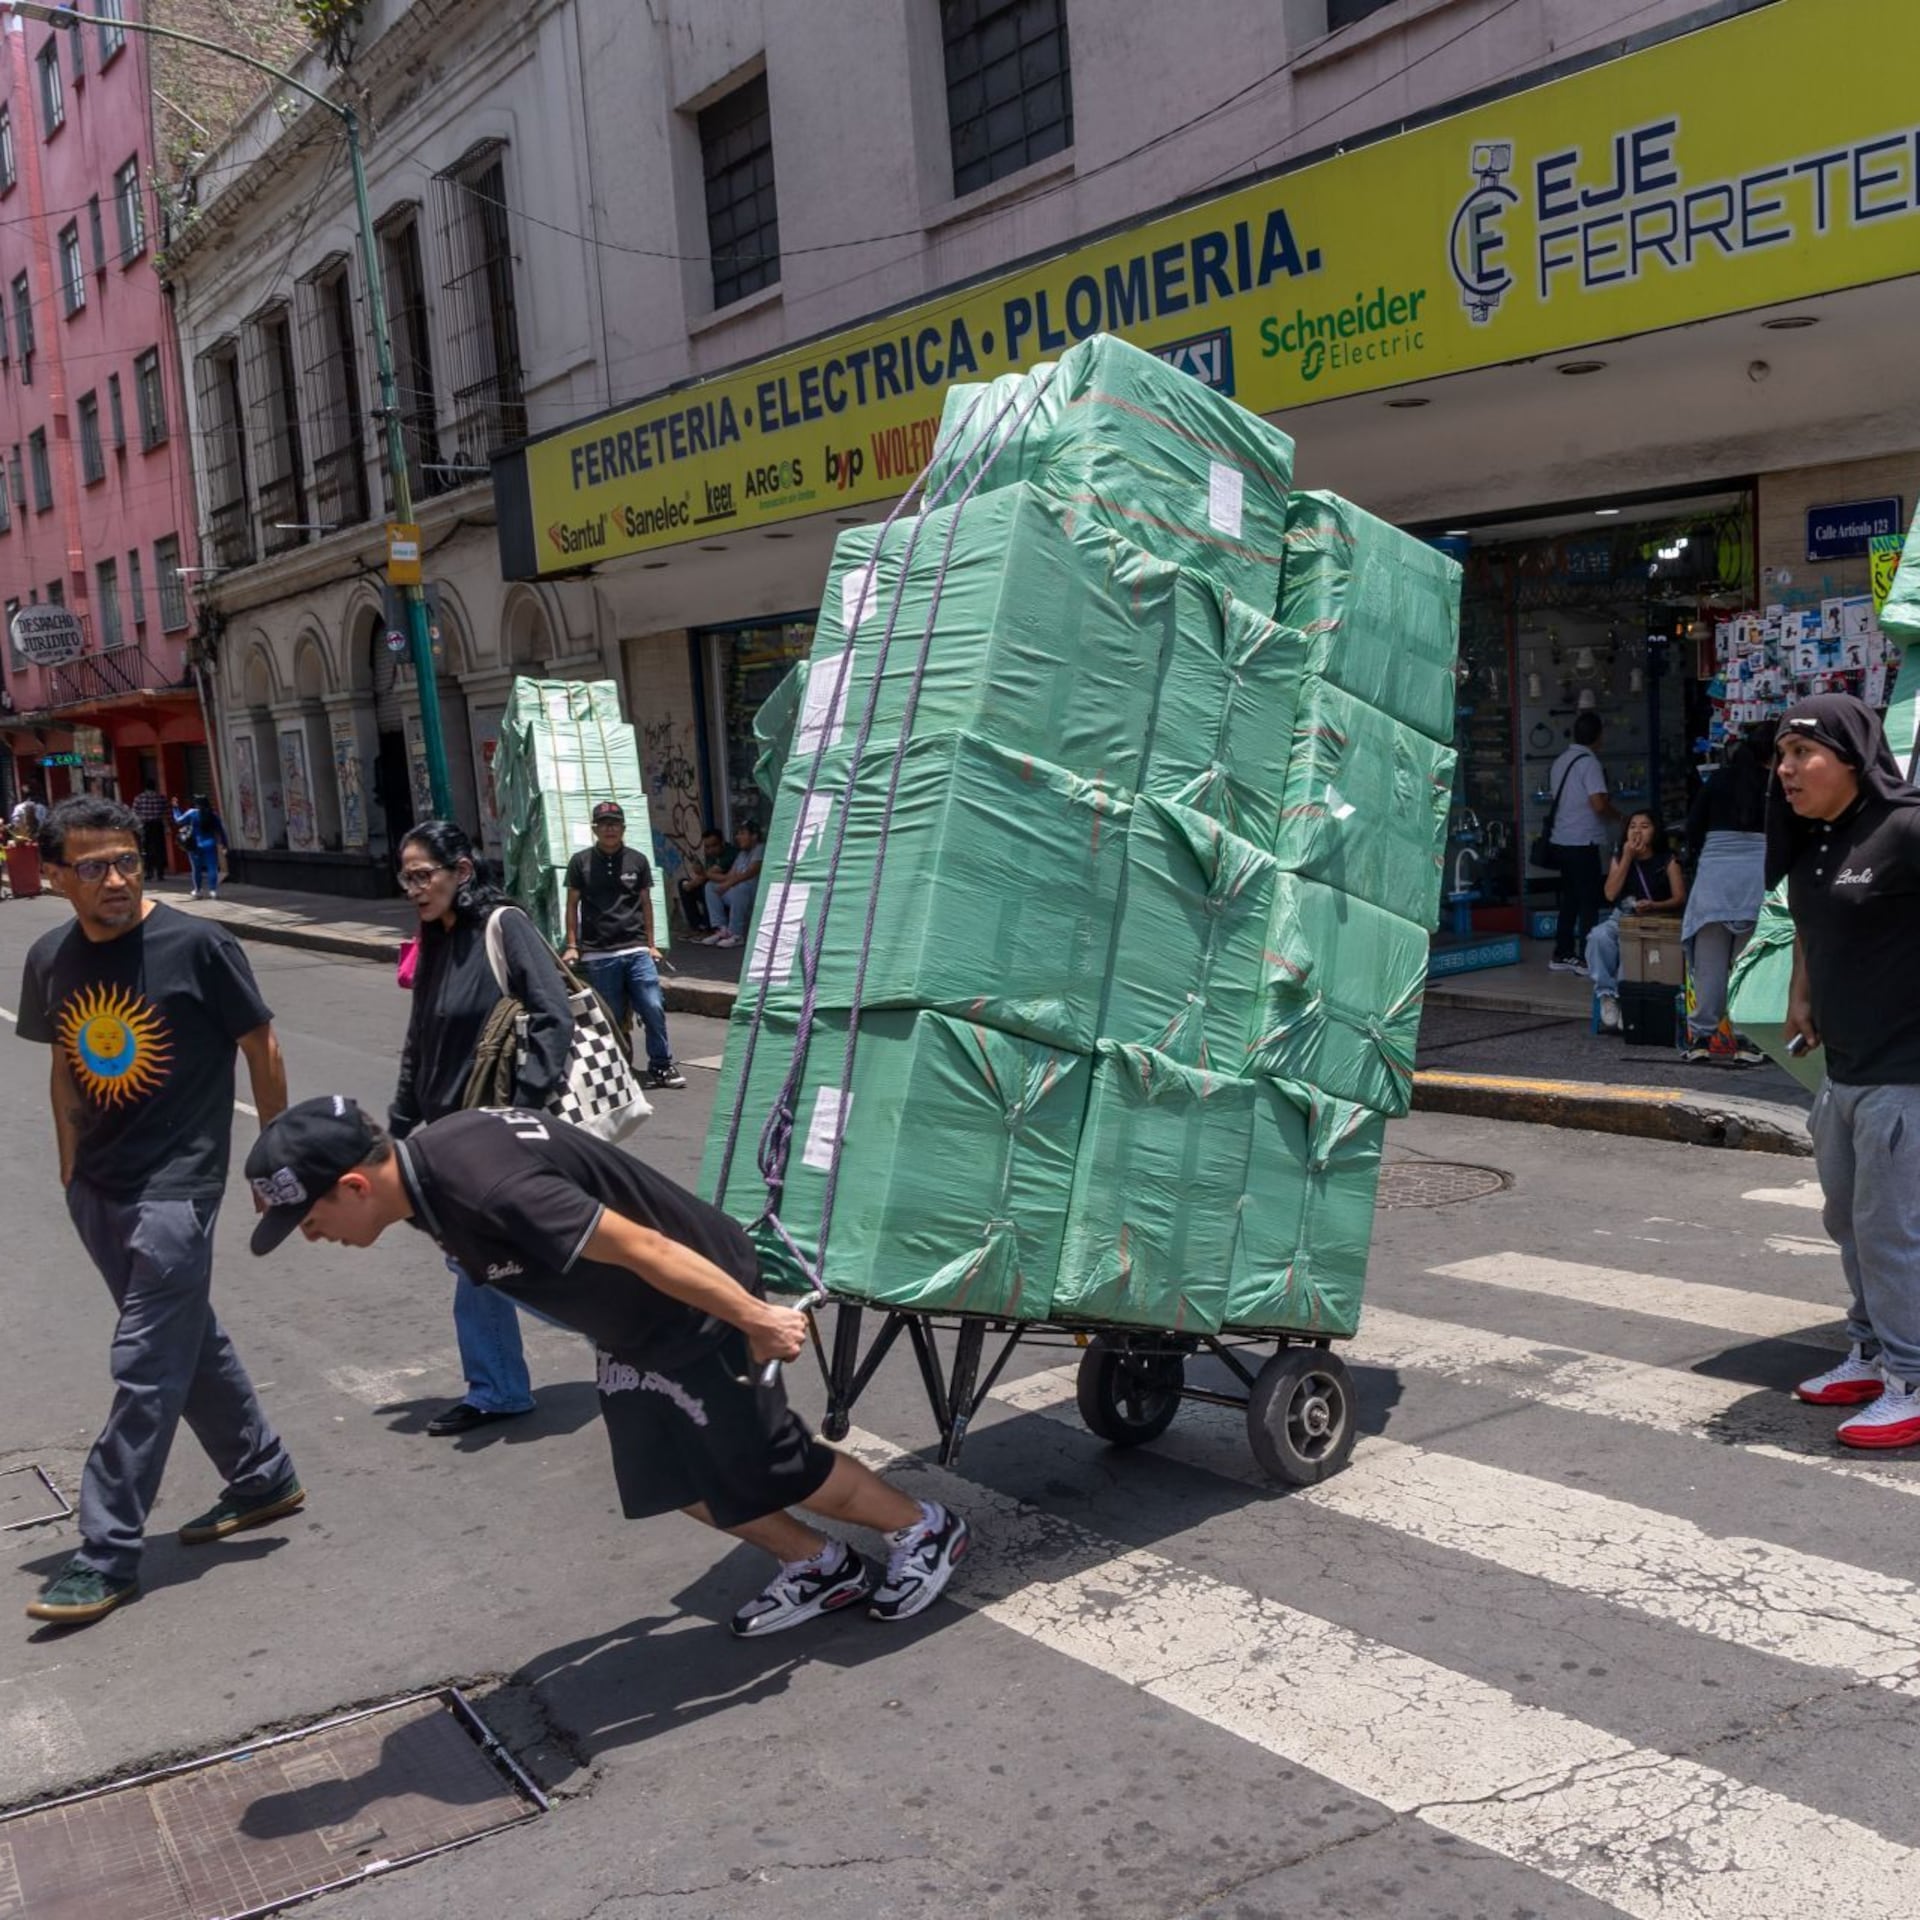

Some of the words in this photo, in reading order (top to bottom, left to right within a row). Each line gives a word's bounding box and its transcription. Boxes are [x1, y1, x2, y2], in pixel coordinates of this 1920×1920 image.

[1537, 120, 1677, 221] EJE
[1539, 131, 1920, 297] FERRETE
[1260, 286, 1426, 357] Schneider
[1331, 329, 1424, 368] Electric
[571, 407, 739, 489] FERRETERIA
[756, 318, 978, 433] ELECTRICA
[826, 445, 863, 490] byp
[560, 513, 606, 553] Santul
[625, 497, 689, 537] Sanelec
[1815, 524, 1837, 540] Calle
[1874, 518, 1888, 534] 123
[18, 614, 74, 633] DESPACHO
